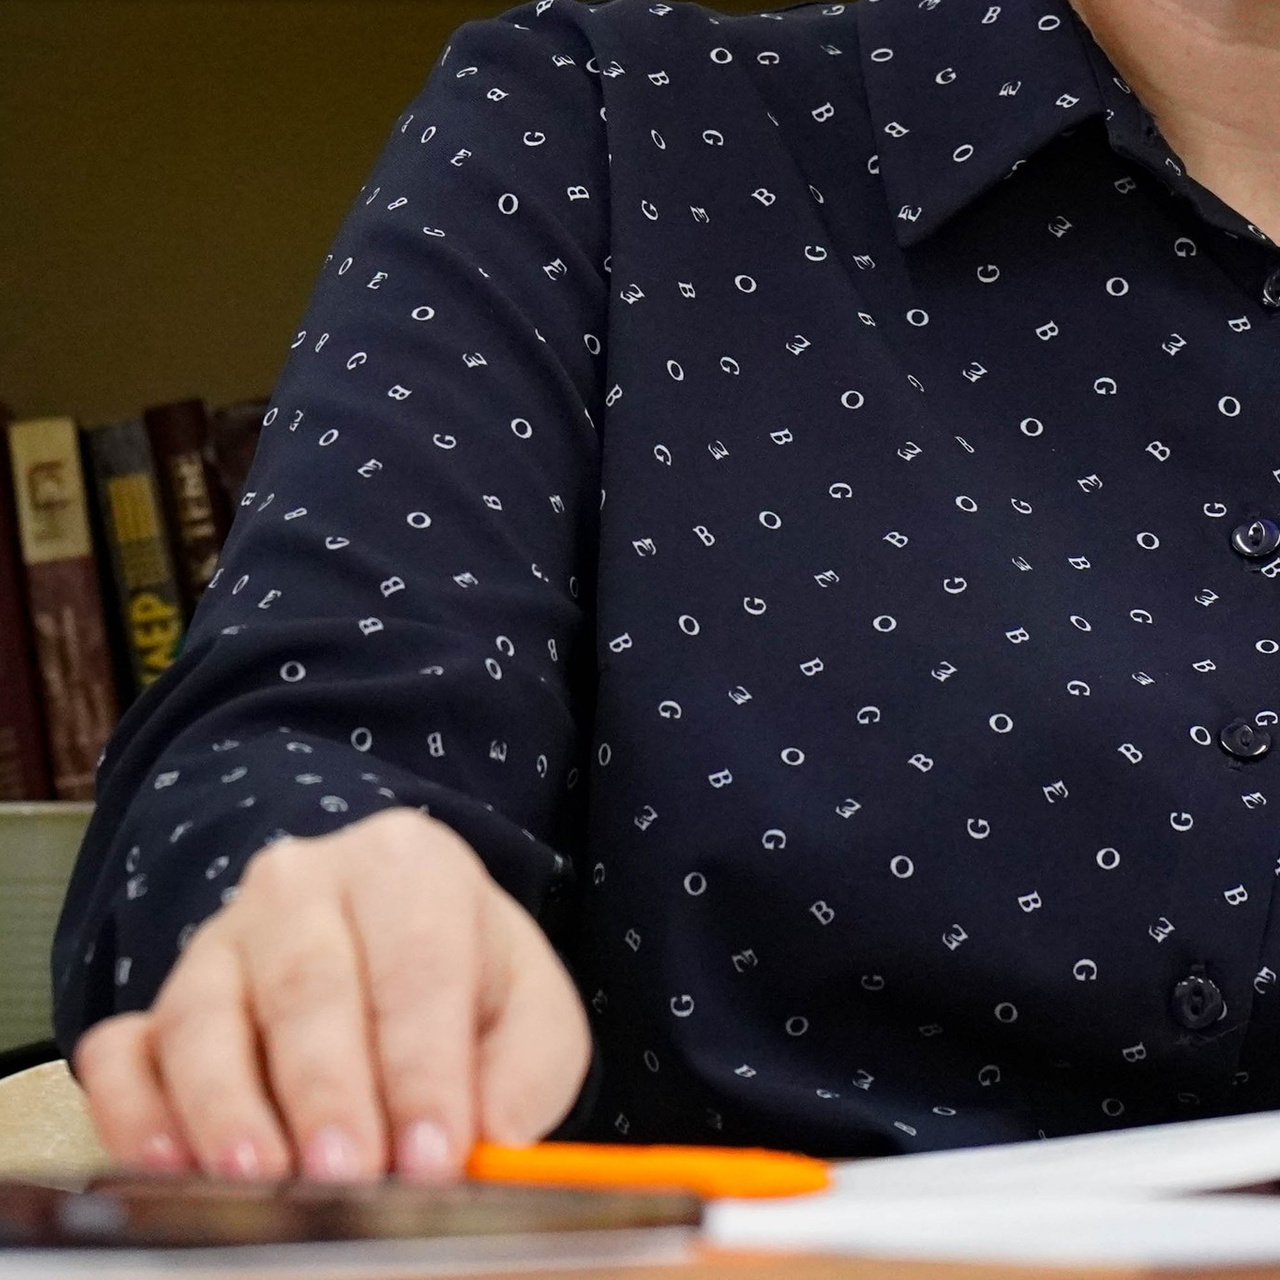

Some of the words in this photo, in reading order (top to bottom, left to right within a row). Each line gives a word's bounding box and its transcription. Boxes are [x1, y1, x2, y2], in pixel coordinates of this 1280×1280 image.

[982, 6, 1001, 24] B
[1038, 15, 1060, 31] O
[710, 48, 733, 64] O
[871, 48, 893, 62] O
[648, 70, 669, 86] B
[487, 88, 509, 101] B
[1055, 94, 1079, 108] B
[811, 102, 834, 122] B
[421, 126, 436, 143] O
[884, 122, 910, 137] B
[651, 130, 666, 149] O
[953, 144, 974, 162] O
[567, 186, 589, 201] B
[751, 188, 776, 206] B
[498, 193, 519, 215] O
[678, 282, 695, 298] B
[735, 275, 757, 293] O
[1106, 277, 1129, 296] O
[411, 306, 435, 321] O
[906, 309, 929, 326] O
[1035, 320, 1059, 340] B
[1228, 316, 1251, 332] B
[584, 334, 600, 355] O
[667, 360, 684, 381] O
[388, 385, 412, 400] B
[606, 384, 623, 407] B
[841, 390, 864, 409] O
[1218, 396, 1241, 417] O
[511, 418, 532, 439] O
[1020, 418, 1043, 436] O
[319, 429, 339, 446] O
[770, 428, 793, 445] B
[1145, 441, 1170, 462] B
[955, 496, 977, 512] O
[407, 512, 431, 528] O
[759, 511, 781, 529] O
[693, 526, 715, 546] B
[883, 532, 908, 548] B
[1136, 532, 1159, 549] O
[1068, 556, 1091, 570] B
[380, 576, 405, 597] B
[358, 617, 384, 635] B
[678, 615, 700, 635] O
[873, 615, 897, 632] O
[1070, 615, 1091, 631] O
[609, 633, 632, 652] B
[1005, 627, 1029, 643] B
[1255, 639, 1279, 654] O
[800, 657, 824, 676] B
[1192, 659, 1216, 672] B
[989, 713, 1013, 733] O
[427, 732, 445, 757] B
[1190, 726, 1211, 745] O
[781, 748, 805, 765] O
[1117, 743, 1143, 764] B
[907, 754, 934, 772] B
[708, 769, 732, 788] B
[890, 855, 914, 878] O
[1096, 848, 1120, 870] O
[684, 872, 707, 895] O
[1018, 891, 1042, 912] B
[1224, 884, 1248, 905] B
[810, 901, 834, 925] B
